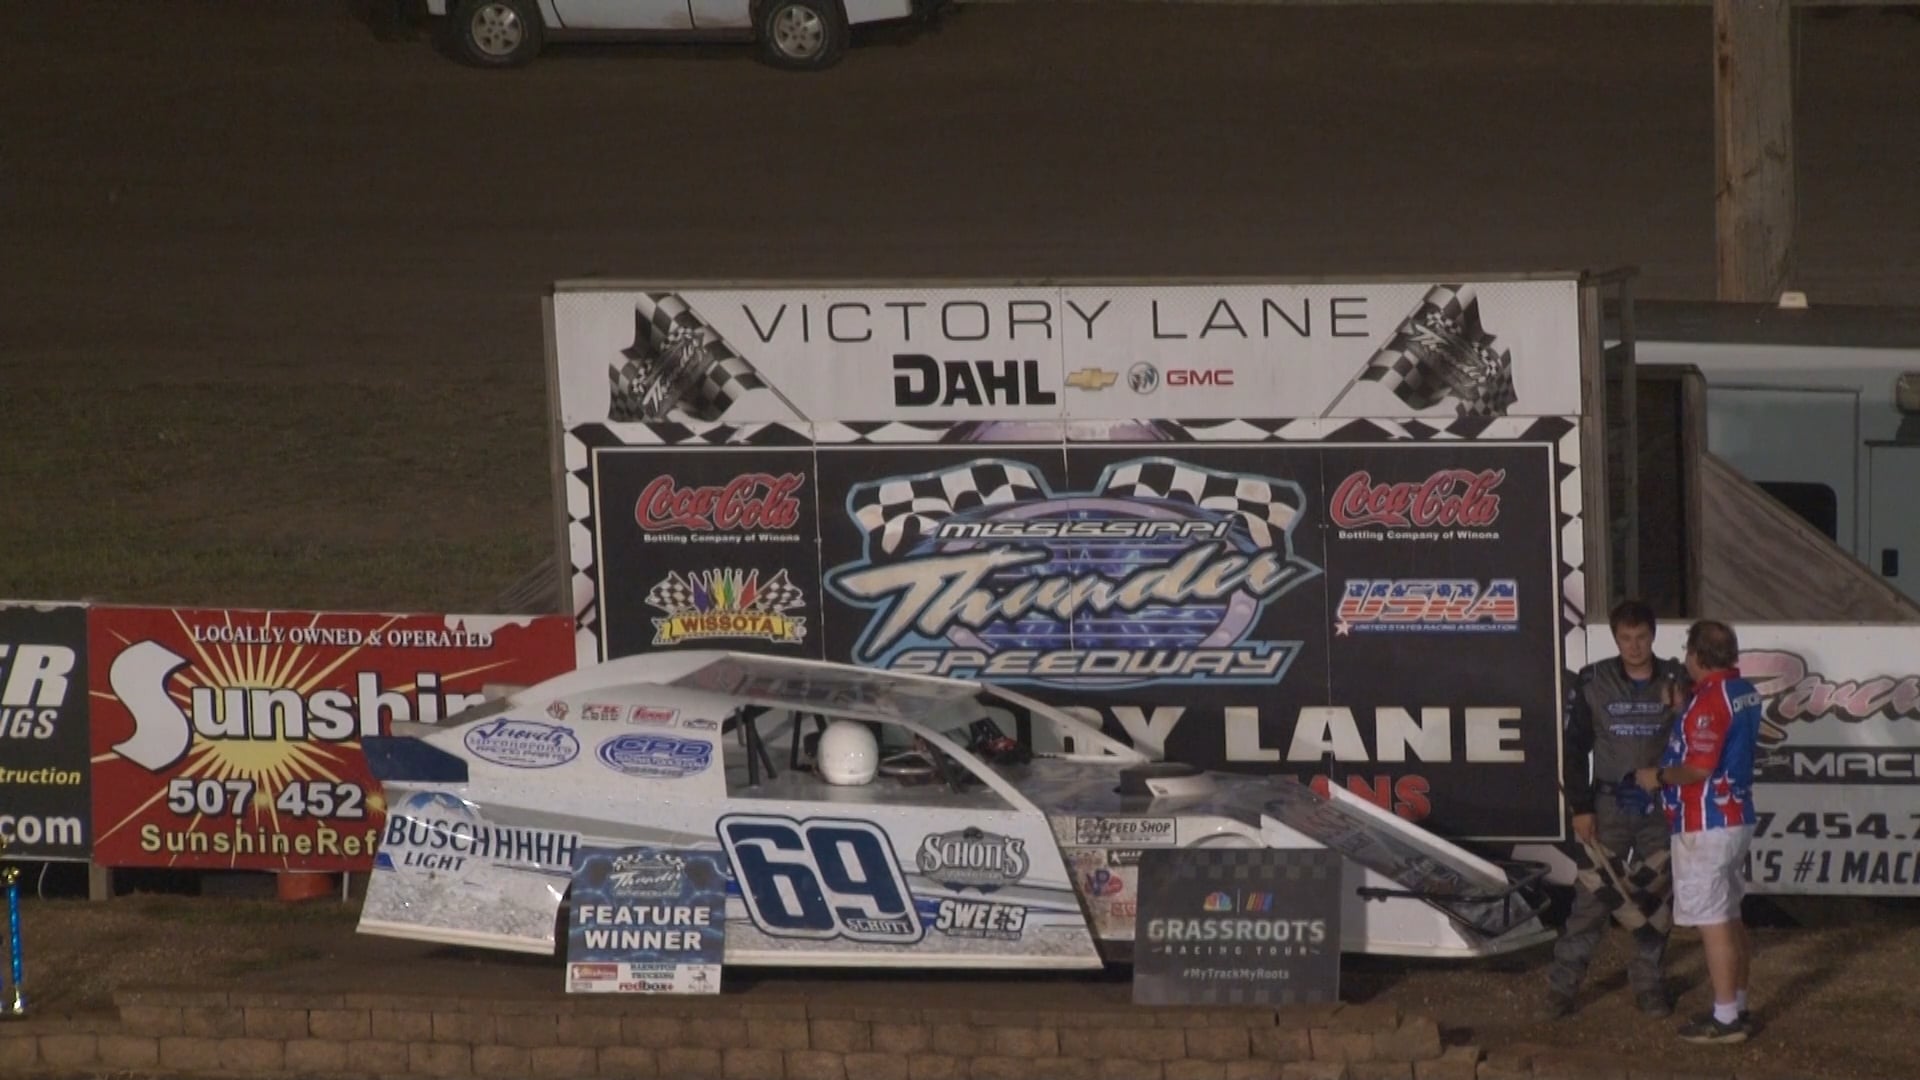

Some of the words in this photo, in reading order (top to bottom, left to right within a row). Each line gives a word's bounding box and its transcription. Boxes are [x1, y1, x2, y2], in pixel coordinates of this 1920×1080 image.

[741, 299, 1111, 344] VICTORY
[1152, 297, 1370, 339] LANE
[892, 353, 1057, 407] DAHL
[1166, 369, 1235, 386] GMC
[635, 473, 806, 531] Coca-Cola
[1330, 468, 1506, 529] Coca-Cola
[644, 533, 687, 544] Bottling
[690, 533, 741, 544] Company
[744, 533, 757, 542] of
[759, 533, 800, 542] Winona
[936, 520, 1229, 539] MISSISSIPPI
[1338, 530, 1383, 541] Bottling
[1387, 531, 1439, 541] Company
[1442, 531, 1454, 540] of
[1457, 531, 1499, 540] Winona
[838, 543, 1297, 658] Thunder
[1337, 579, 1519, 622] USRA
[193, 625, 285, 644] LOCALLY
[289, 627, 362, 645] OWNED
[367, 629, 382, 646] &
[387, 629, 494, 648] OPERATED
[680, 615, 776, 634] WISSOTA
[893, 648, 1285, 676] SPEEDWAY
[1223, 706, 1526, 763] LANE
[1794, 752, 1920, 777] MAC
[167, 779, 253, 815] 507
[276, 782, 364, 818] 452
[1140, 820, 1171, 833] SHOP
[140, 824, 377, 856] SunshineRef
[404, 851, 467, 872] LIGHT
[1793, 851, 1832, 884] #1
[727, 824, 907, 931] 69
[578, 905, 711, 926] FEATURE
[935, 899, 1026, 932] SWEE'S
[584, 930, 702, 950] WINNER
[1147, 918, 1327, 942] GRASSROOTS
[1164, 945, 1242, 956] RACING
[1256, 946, 1308, 957] TOUR
[1182, 968, 1290, 982] #MyTrackMyRoots
